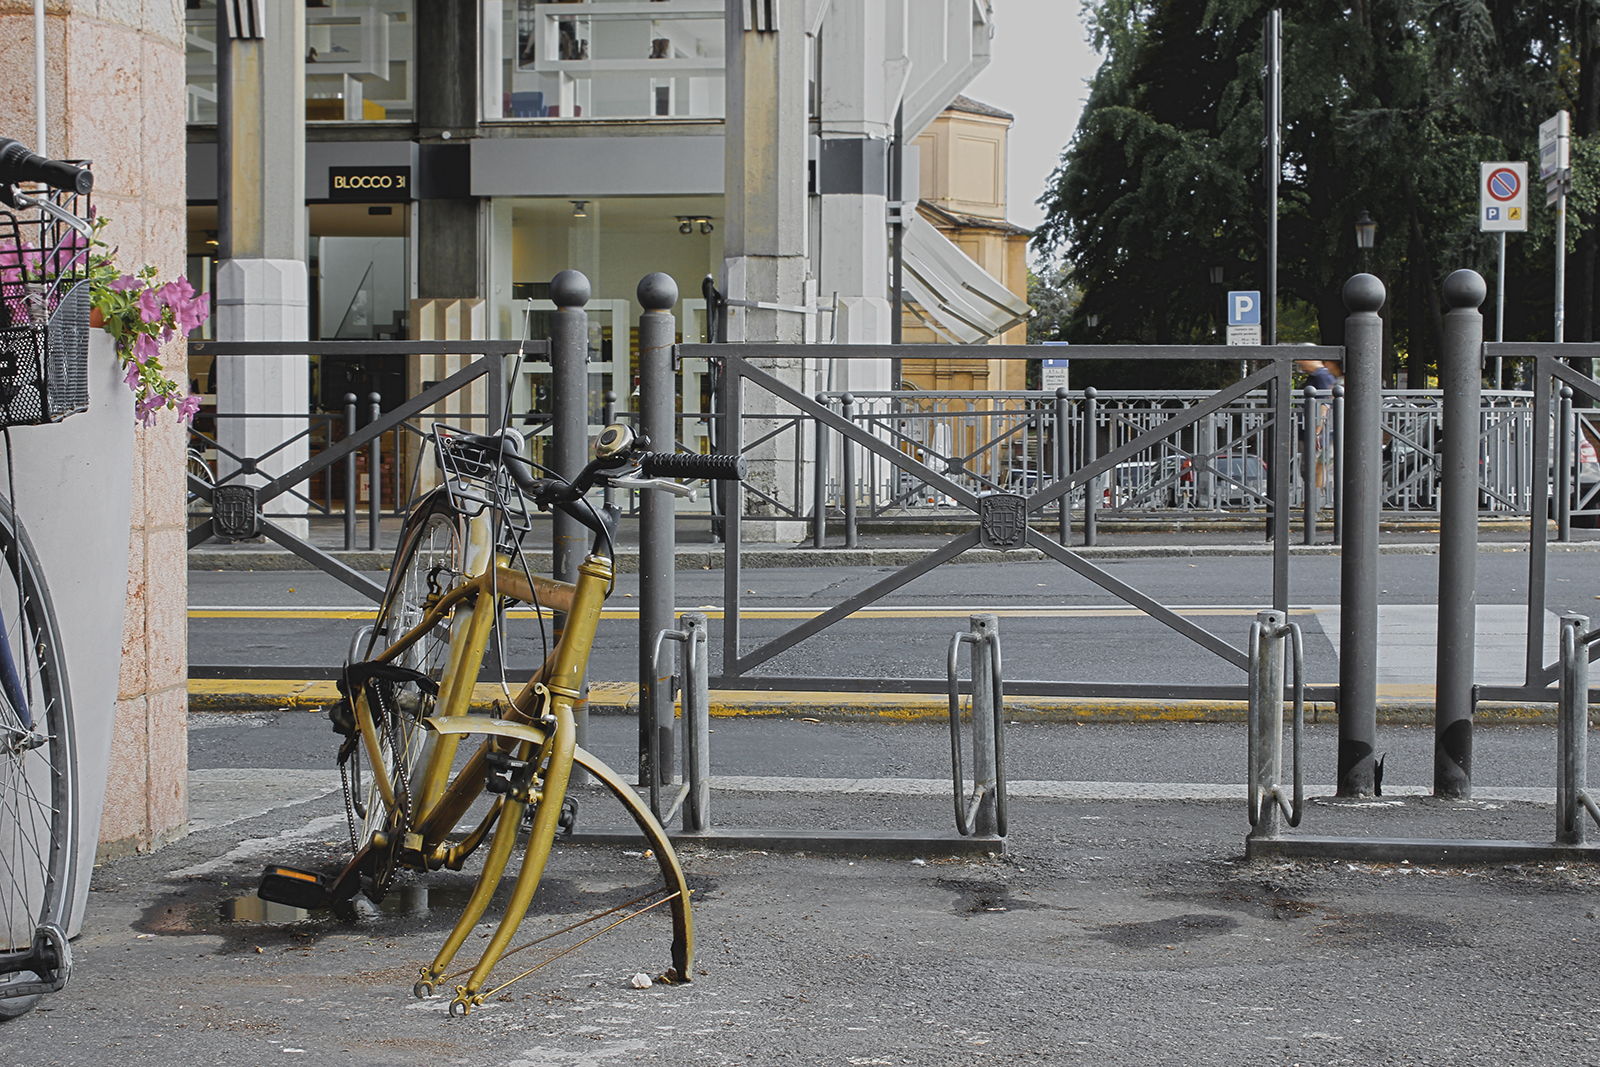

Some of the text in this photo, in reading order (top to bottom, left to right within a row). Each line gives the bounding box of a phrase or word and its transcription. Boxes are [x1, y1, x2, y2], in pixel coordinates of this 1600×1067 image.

[334, 175, 406, 189] BLOCCO 31
[1488, 208, 1497, 219] P
[1235, 296, 1253, 321] P
